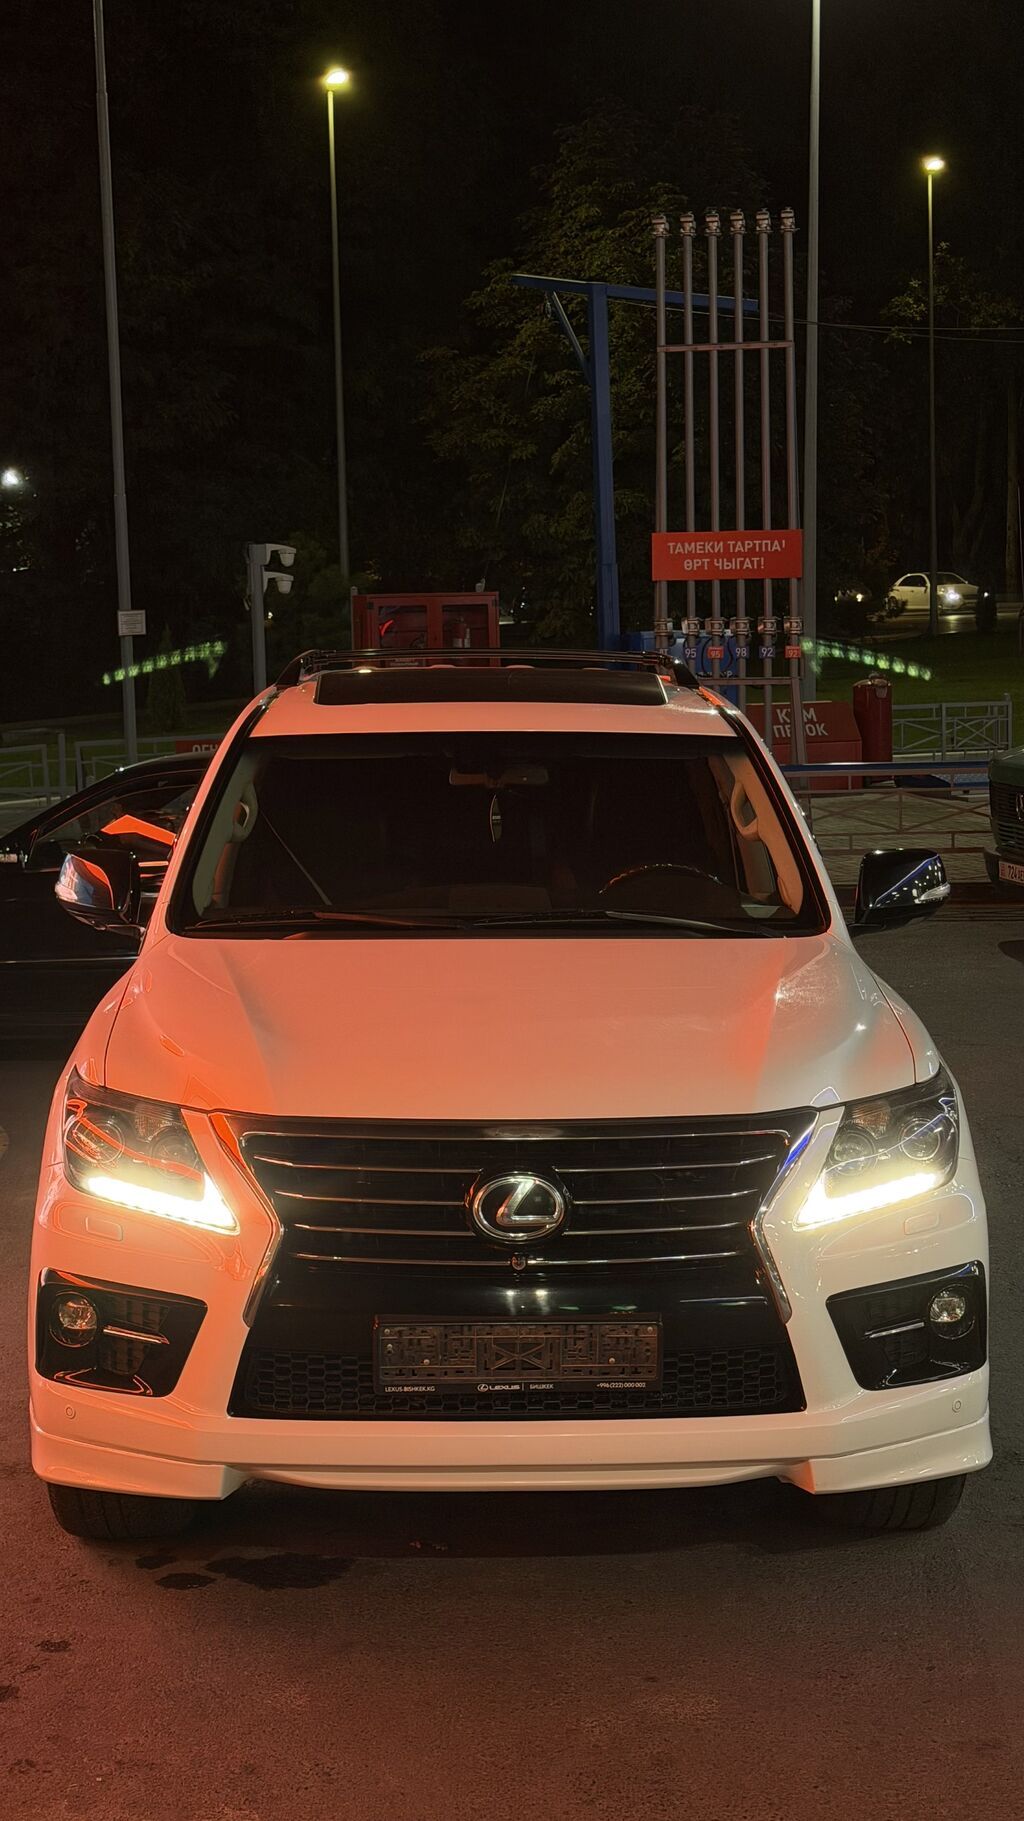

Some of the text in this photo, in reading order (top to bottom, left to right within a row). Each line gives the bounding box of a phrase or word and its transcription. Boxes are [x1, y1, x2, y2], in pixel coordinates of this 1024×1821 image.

[667, 541, 723, 554] ТАМЕКИ
[684, 557, 764, 571] ӨРТ ЧЫГАТ!
[685, 648, 697, 658] 95
[735, 647, 747, 657] 98
[761, 647, 773, 657] 92
[788, 650, 798, 658] 92
[776, 708, 817, 723] КМ
[773, 723, 828, 738] ПЕОК
